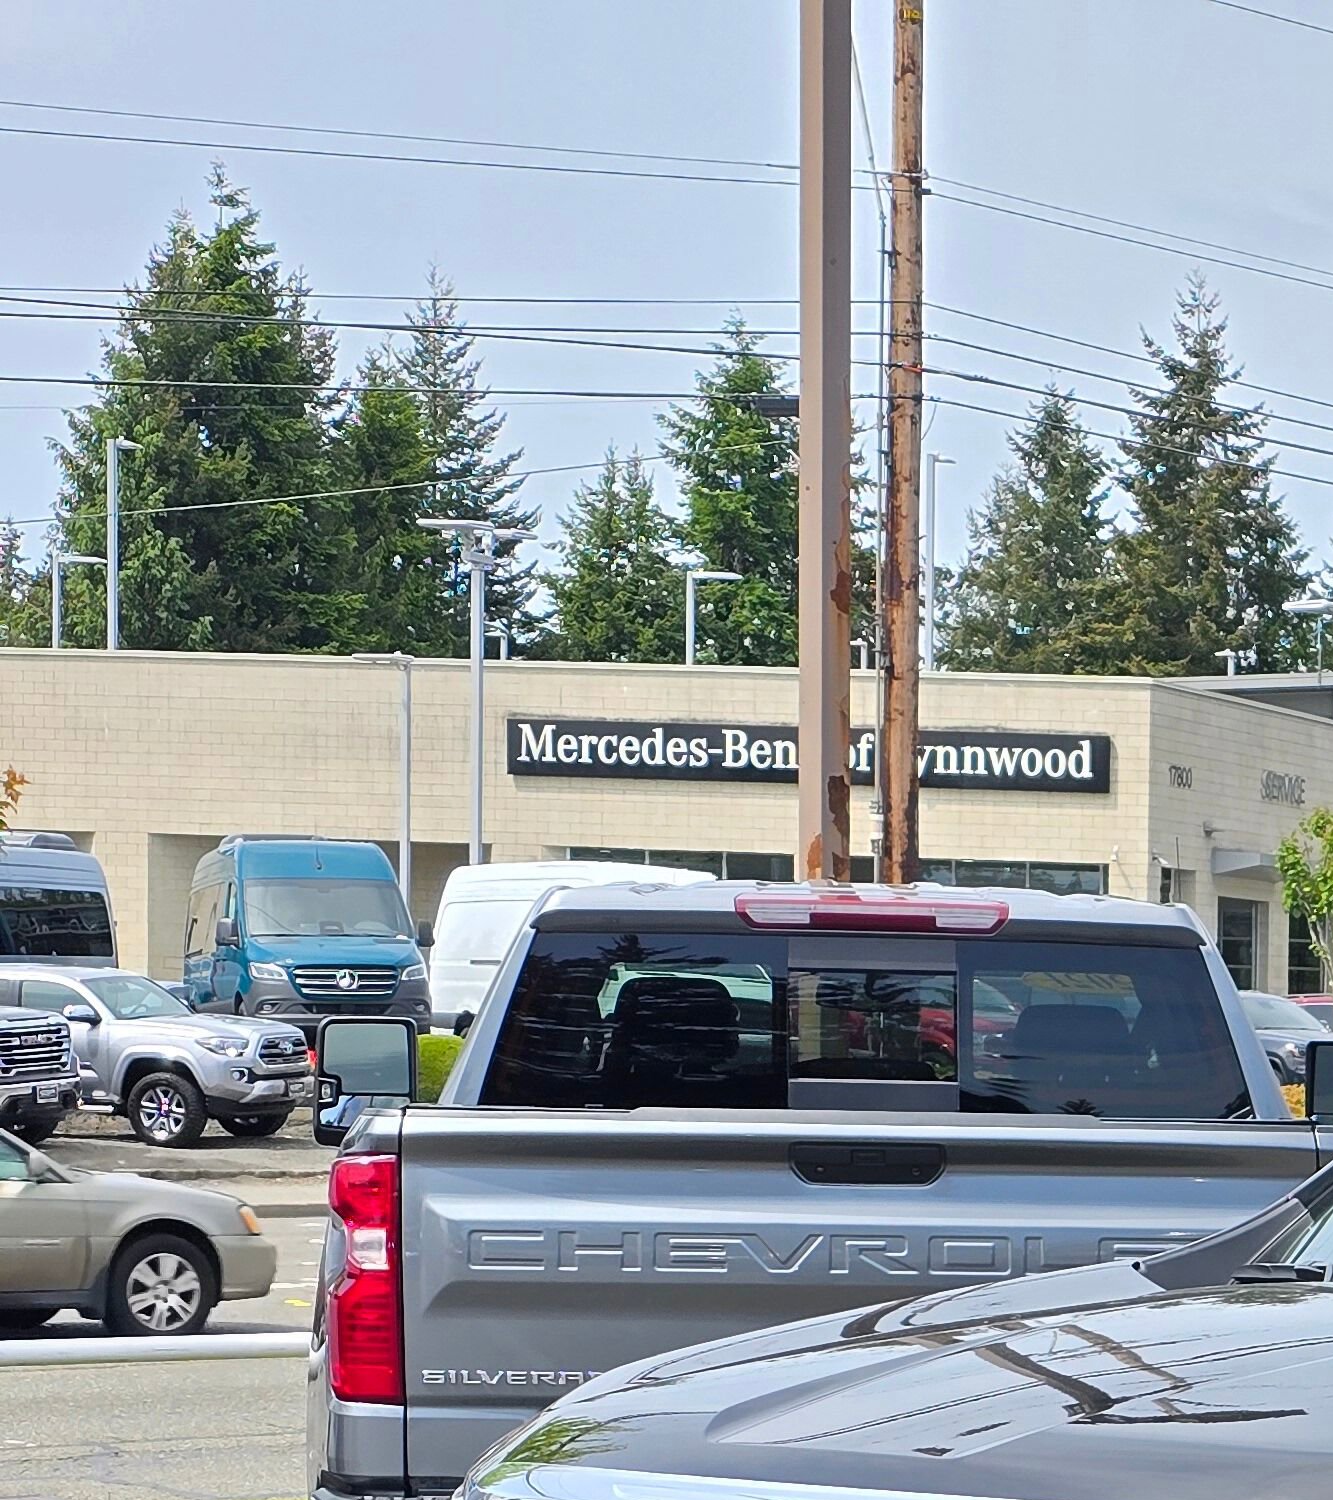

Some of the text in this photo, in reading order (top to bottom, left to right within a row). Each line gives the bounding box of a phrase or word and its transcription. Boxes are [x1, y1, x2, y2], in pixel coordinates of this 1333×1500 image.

[517, 723, 1094, 779] Mercedes-Ben f ynnwood
[1168, 765, 1193, 789] 17800
[1260, 769, 1306, 804] SERVICE
[421, 1369, 605, 1385] SILVERA
